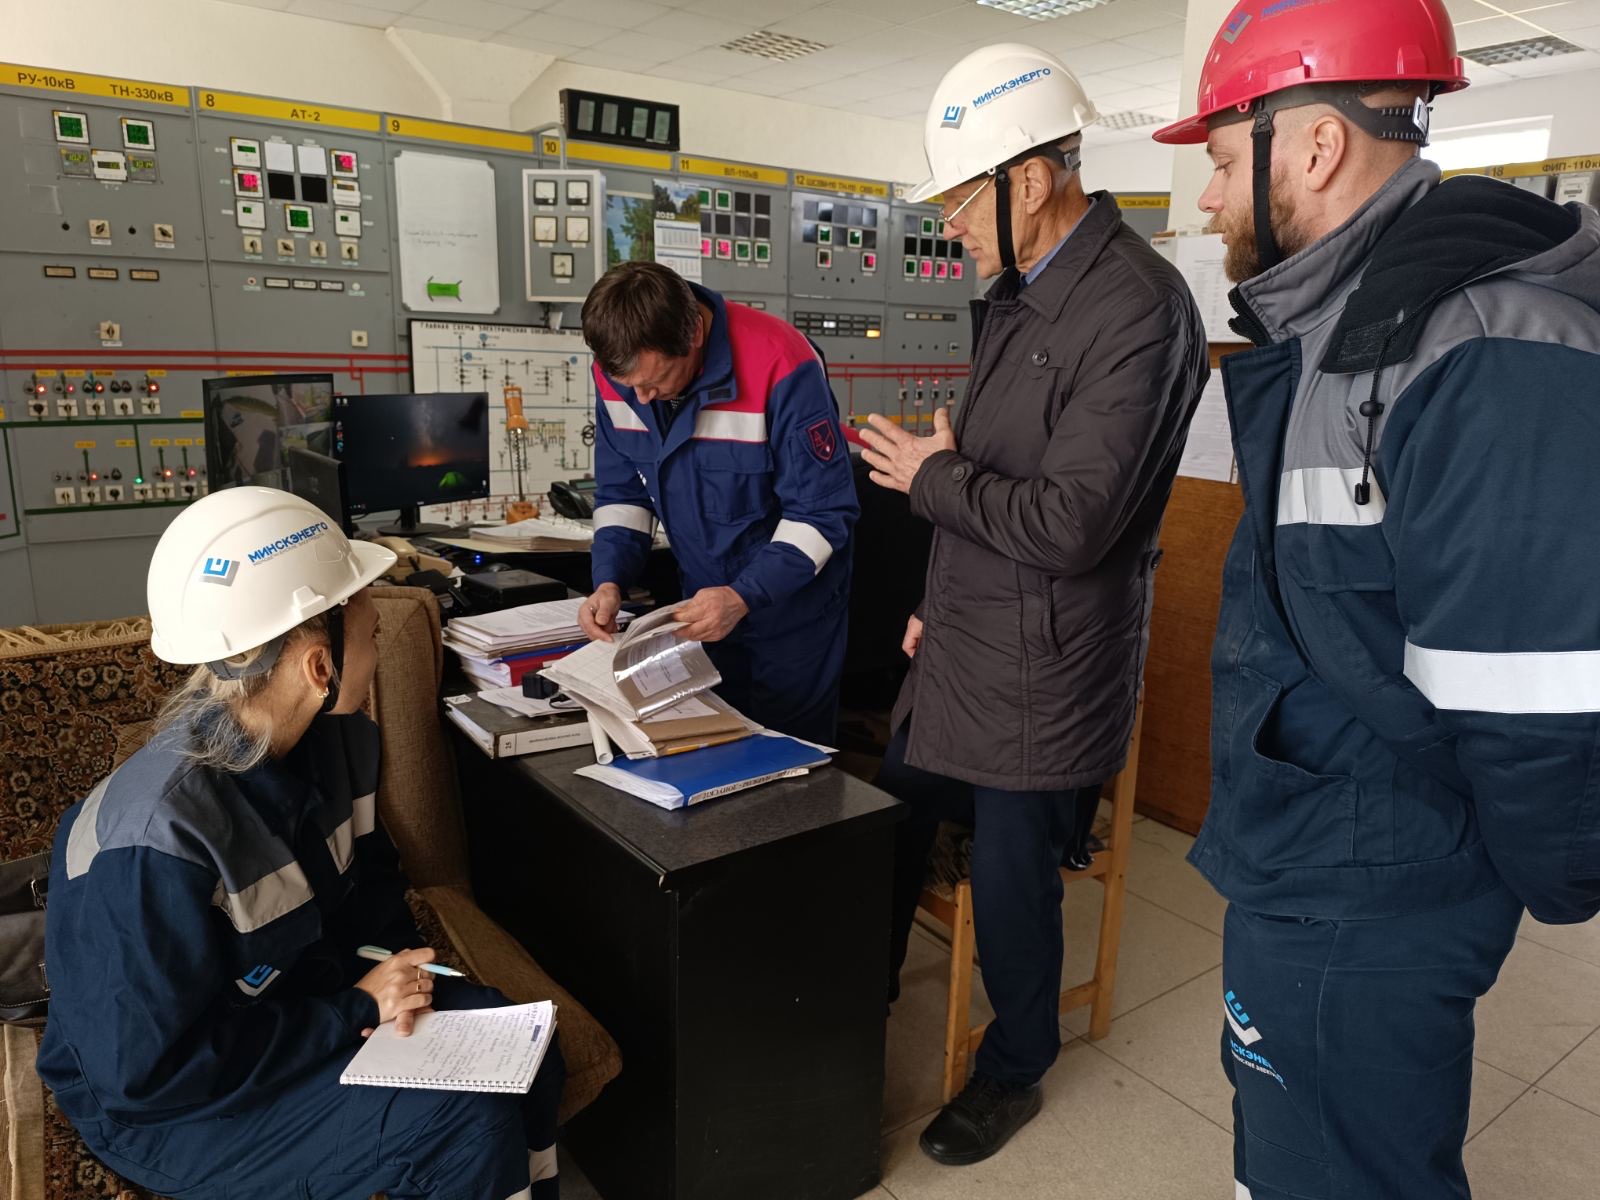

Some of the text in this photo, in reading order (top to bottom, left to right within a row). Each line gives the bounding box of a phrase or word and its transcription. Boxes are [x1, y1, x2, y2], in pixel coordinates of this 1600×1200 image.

[17, 71, 76, 90] РУ-10кВ
[110, 84, 174, 102] ТН-330кВ
[972, 67, 1051, 108] МИНСКЭНЕРГО
[205, 94, 215, 107] 8
[290, 108, 321, 122] АТ-2
[391, 119, 401, 132] 9
[545, 141, 557, 153] 10
[681, 159, 690, 170] 11
[1491, 166, 1505, 177] 18
[248, 521, 328, 563] МИНСКЭНЕРГО
